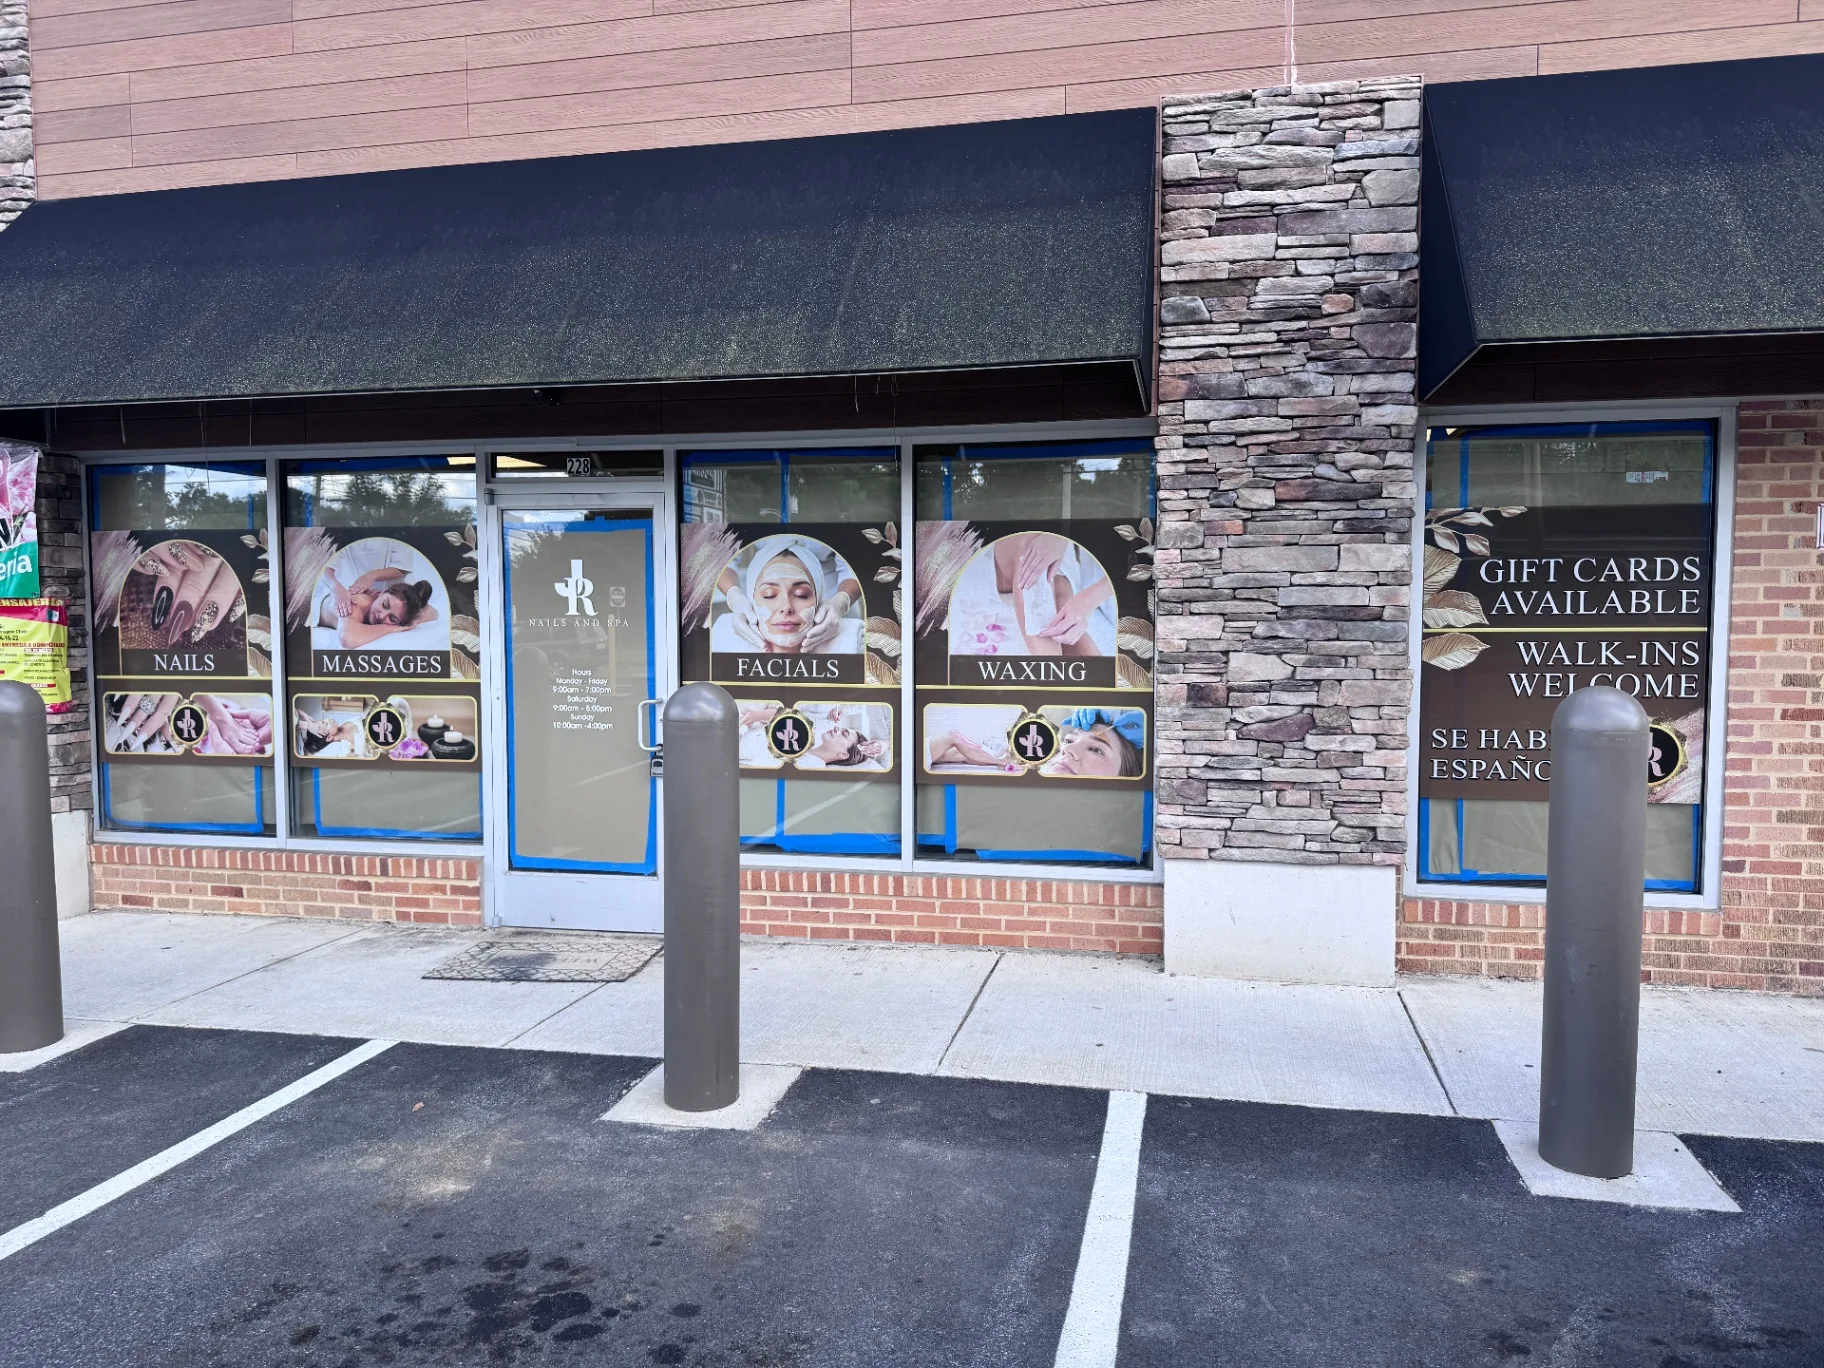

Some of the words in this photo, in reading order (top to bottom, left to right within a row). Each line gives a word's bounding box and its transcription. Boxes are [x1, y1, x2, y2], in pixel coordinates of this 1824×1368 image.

[567, 458, 590, 474] 228
[1479, 558, 1563, 583] GIFT
[1573, 556, 1701, 583] CARDS
[0, 597, 65, 607] NSAJERIA
[1490, 589, 1701, 615] AVAILABLE
[529, 619, 567, 627] NAILS
[574, 619, 600, 627] AND
[607, 619, 629, 627] SPA
[1516, 640, 1701, 667] WALK-INS
[154, 653, 216, 672] NAILS
[322, 655, 443, 674] MASSAGES
[736, 658, 840, 679] FACIALS
[978, 660, 1087, 681] WAXING
[571, 668, 592, 676] Hours
[556, 677, 583, 686] Monday
[588, 677, 608, 686] Friday
[552, 686, 579, 694] 9:00am
[585, 687, 612, 695] 7:00pm
[567, 695, 598, 704] Saturday
[553, 704, 579, 712] 9:00am
[553, 721, 583, 729] 10:00am
[570, 713, 595, 721] Sunday
[1432, 728, 1469, 750] SE
[1478, 729, 1551, 750] HAB
[1430, 755, 1551, 781] ESPAÑO
